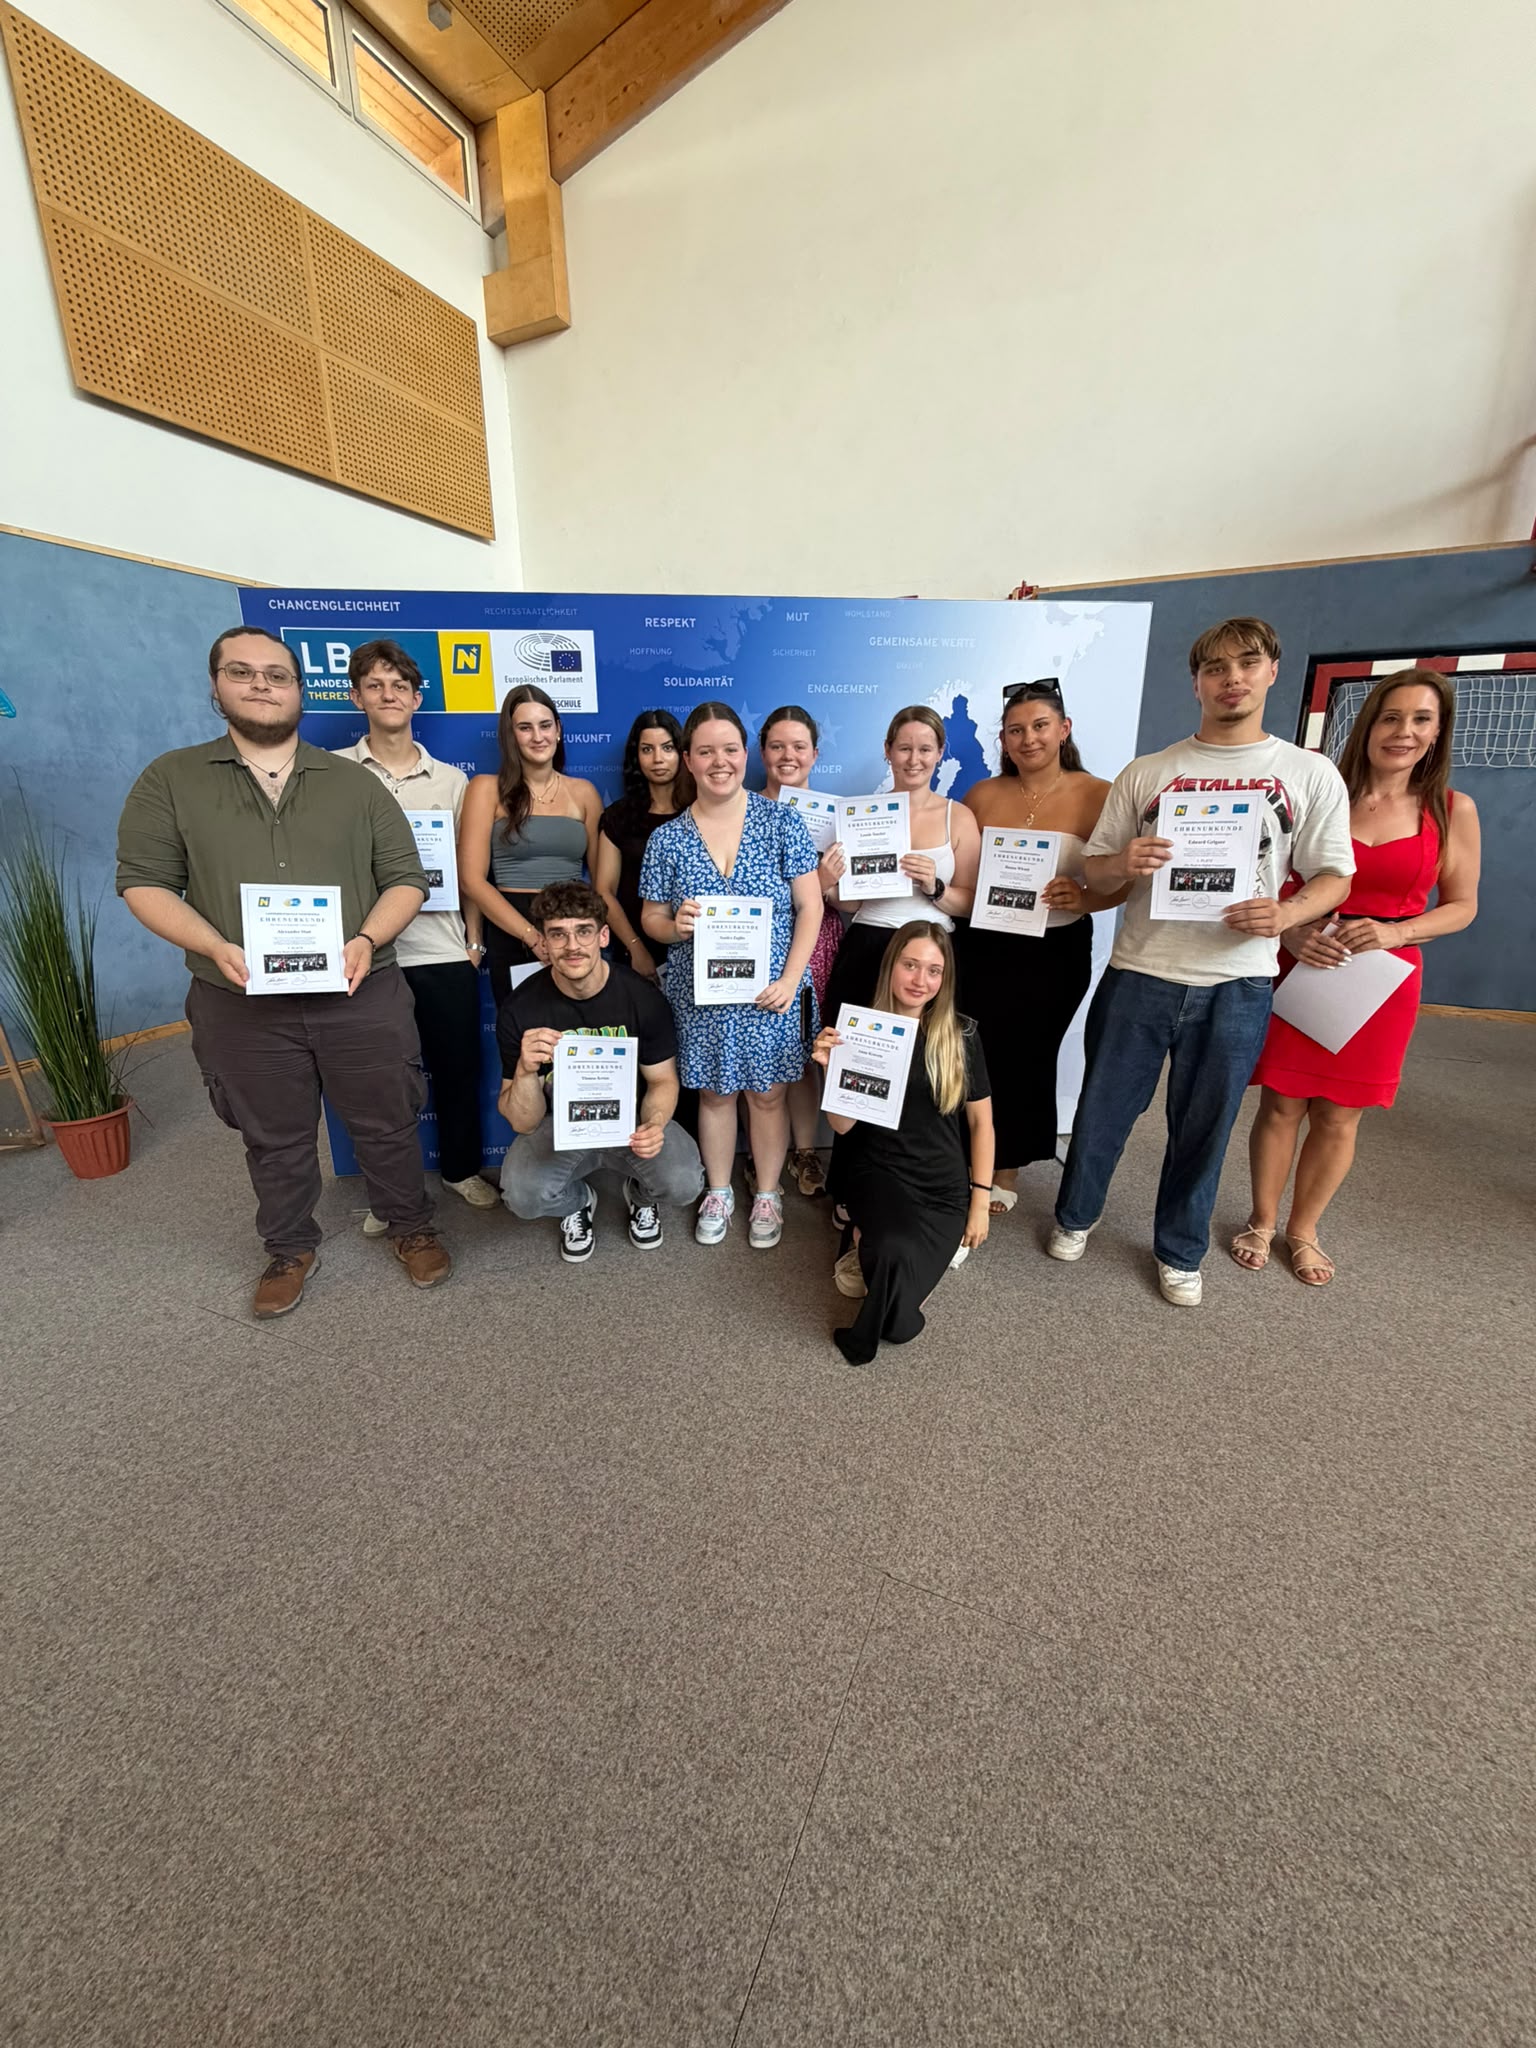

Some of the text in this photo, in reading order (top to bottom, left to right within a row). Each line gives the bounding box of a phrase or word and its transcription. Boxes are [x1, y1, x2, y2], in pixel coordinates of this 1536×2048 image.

[268, 599, 401, 612] CHANCENGLEICHHEIT
[484, 607, 578, 616] RECHTSSTAATLICHKEIT
[786, 612, 810, 622] MUT
[645, 617, 697, 629] RESPEKT
[869, 636, 977, 648] GEMEINSAME WERTE
[629, 647, 673, 656] HOFFNUNG
[772, 648, 816, 657] SICHERHEIT
[301, 641, 363, 674] LB
[505, 676, 547, 684] Europäisches
[663, 675, 735, 687] SOLIDARITÄT
[807, 684, 879, 694] ENGAGEMENT
[308, 691, 350, 700] THERES
